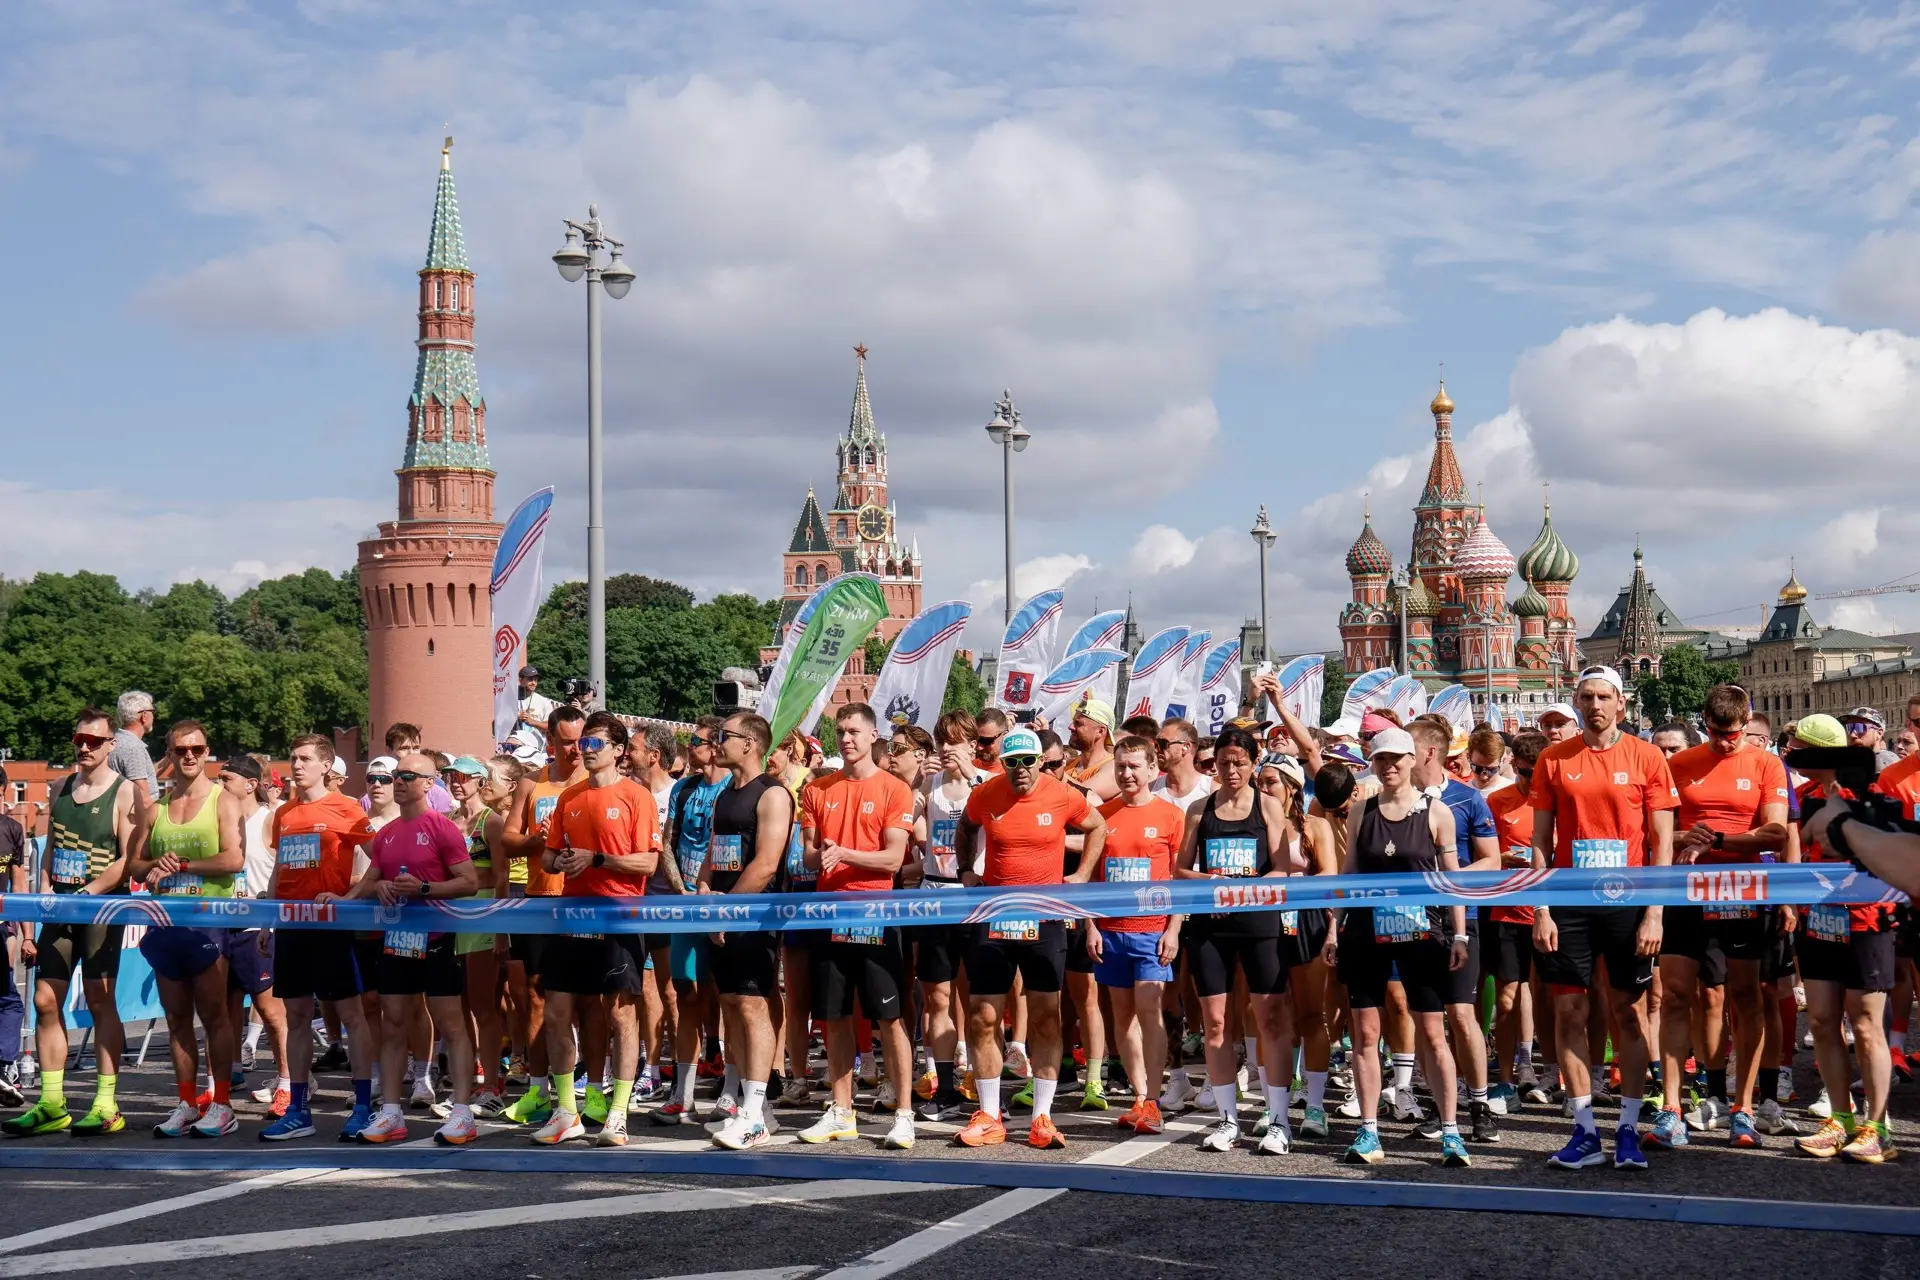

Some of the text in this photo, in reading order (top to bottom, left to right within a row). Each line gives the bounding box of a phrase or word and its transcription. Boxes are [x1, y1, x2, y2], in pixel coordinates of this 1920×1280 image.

[825, 627, 845, 638] 4:30
[819, 639, 841, 656] 35
[1210, 693, 1226, 736] ПСБ
[1005, 737, 1033, 748] ciele
[606, 807, 619, 819] 10
[862, 802, 874, 814] 10
[1036, 813, 1052, 826] 10
[1144, 827, 1157, 838] 10
[282, 844, 316, 862] 72231
[1210, 849, 1254, 867] 74768
[1577, 850, 1621, 868] 72031
[54, 858, 83, 876] 73643
[732, 860, 738, 869] B
[1108, 867, 1148, 882] 75469
[190, 886, 197, 894] B
[1687, 870, 1768, 902] СТАРТ
[1134, 886, 1172, 912] 10
[1214, 885, 1286, 908] СТАРТ
[642, 907, 684, 920] ПСБ
[699, 906, 711, 919] 5
[775, 904, 797, 919] 10
[1741, 909, 1748, 918] B
[1808, 910, 1846, 934] 73450
[388, 930, 424, 949] 74390
[870, 936, 878, 944] B
[1028, 929, 1036, 938] B
[1413, 932, 1420, 940] B
[413, 949, 420, 958] B
